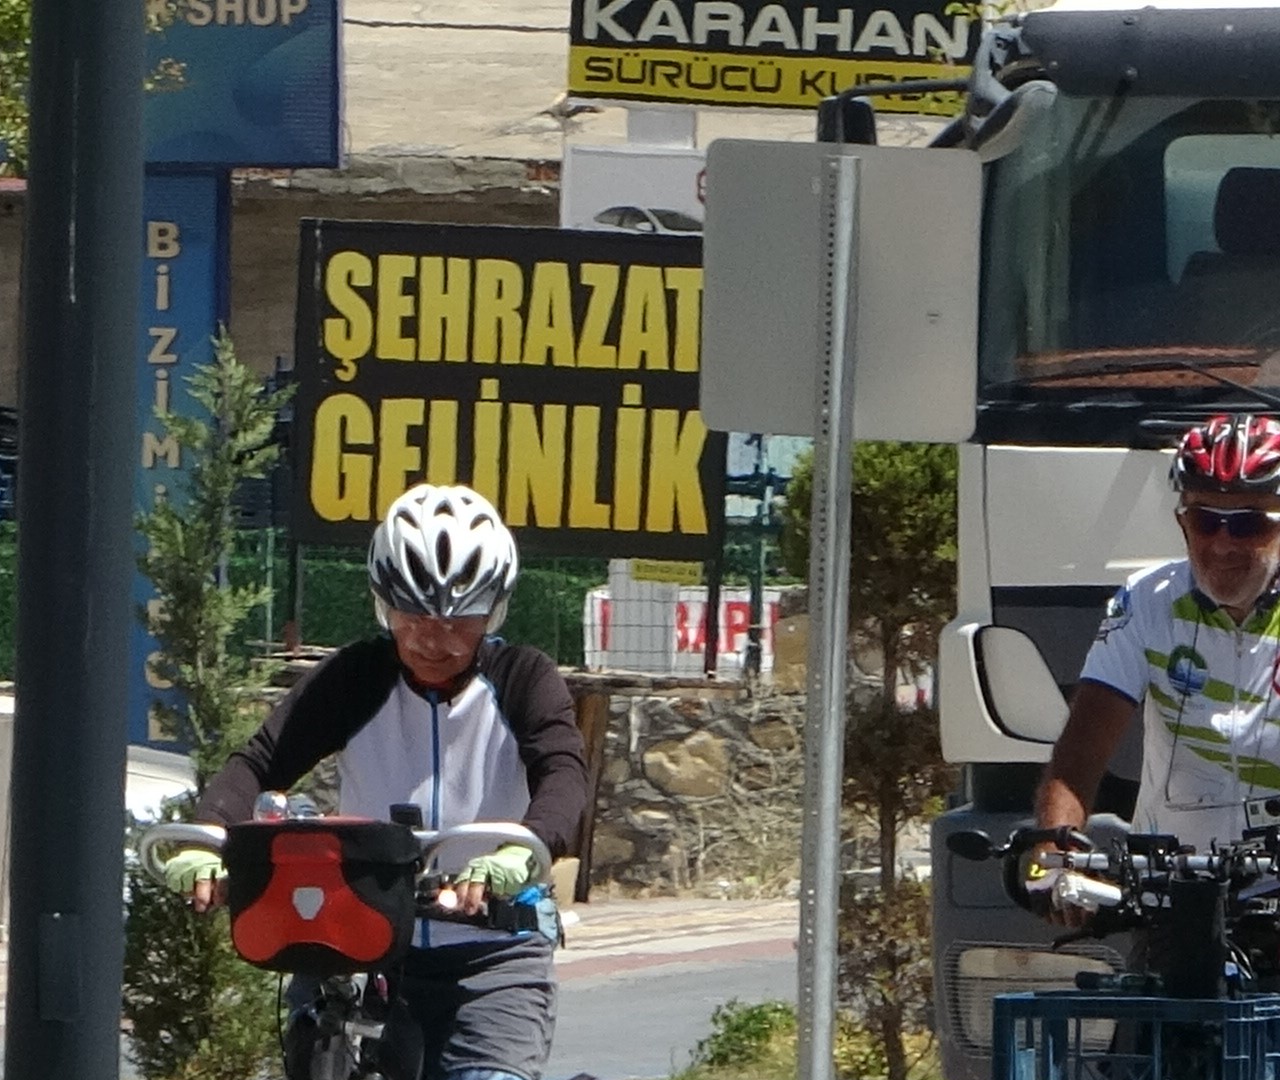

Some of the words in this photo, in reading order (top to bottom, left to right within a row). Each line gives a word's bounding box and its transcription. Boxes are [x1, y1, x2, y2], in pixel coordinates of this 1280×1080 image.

[186, 0, 308, 26] SHOP
[582, 0, 969, 58] KARAHAN
[584, 52, 782, 94] SÜRÜCÜ
[323, 250, 704, 381] ŞEHRAZAT
[310, 377, 708, 535] GELİNLİK
